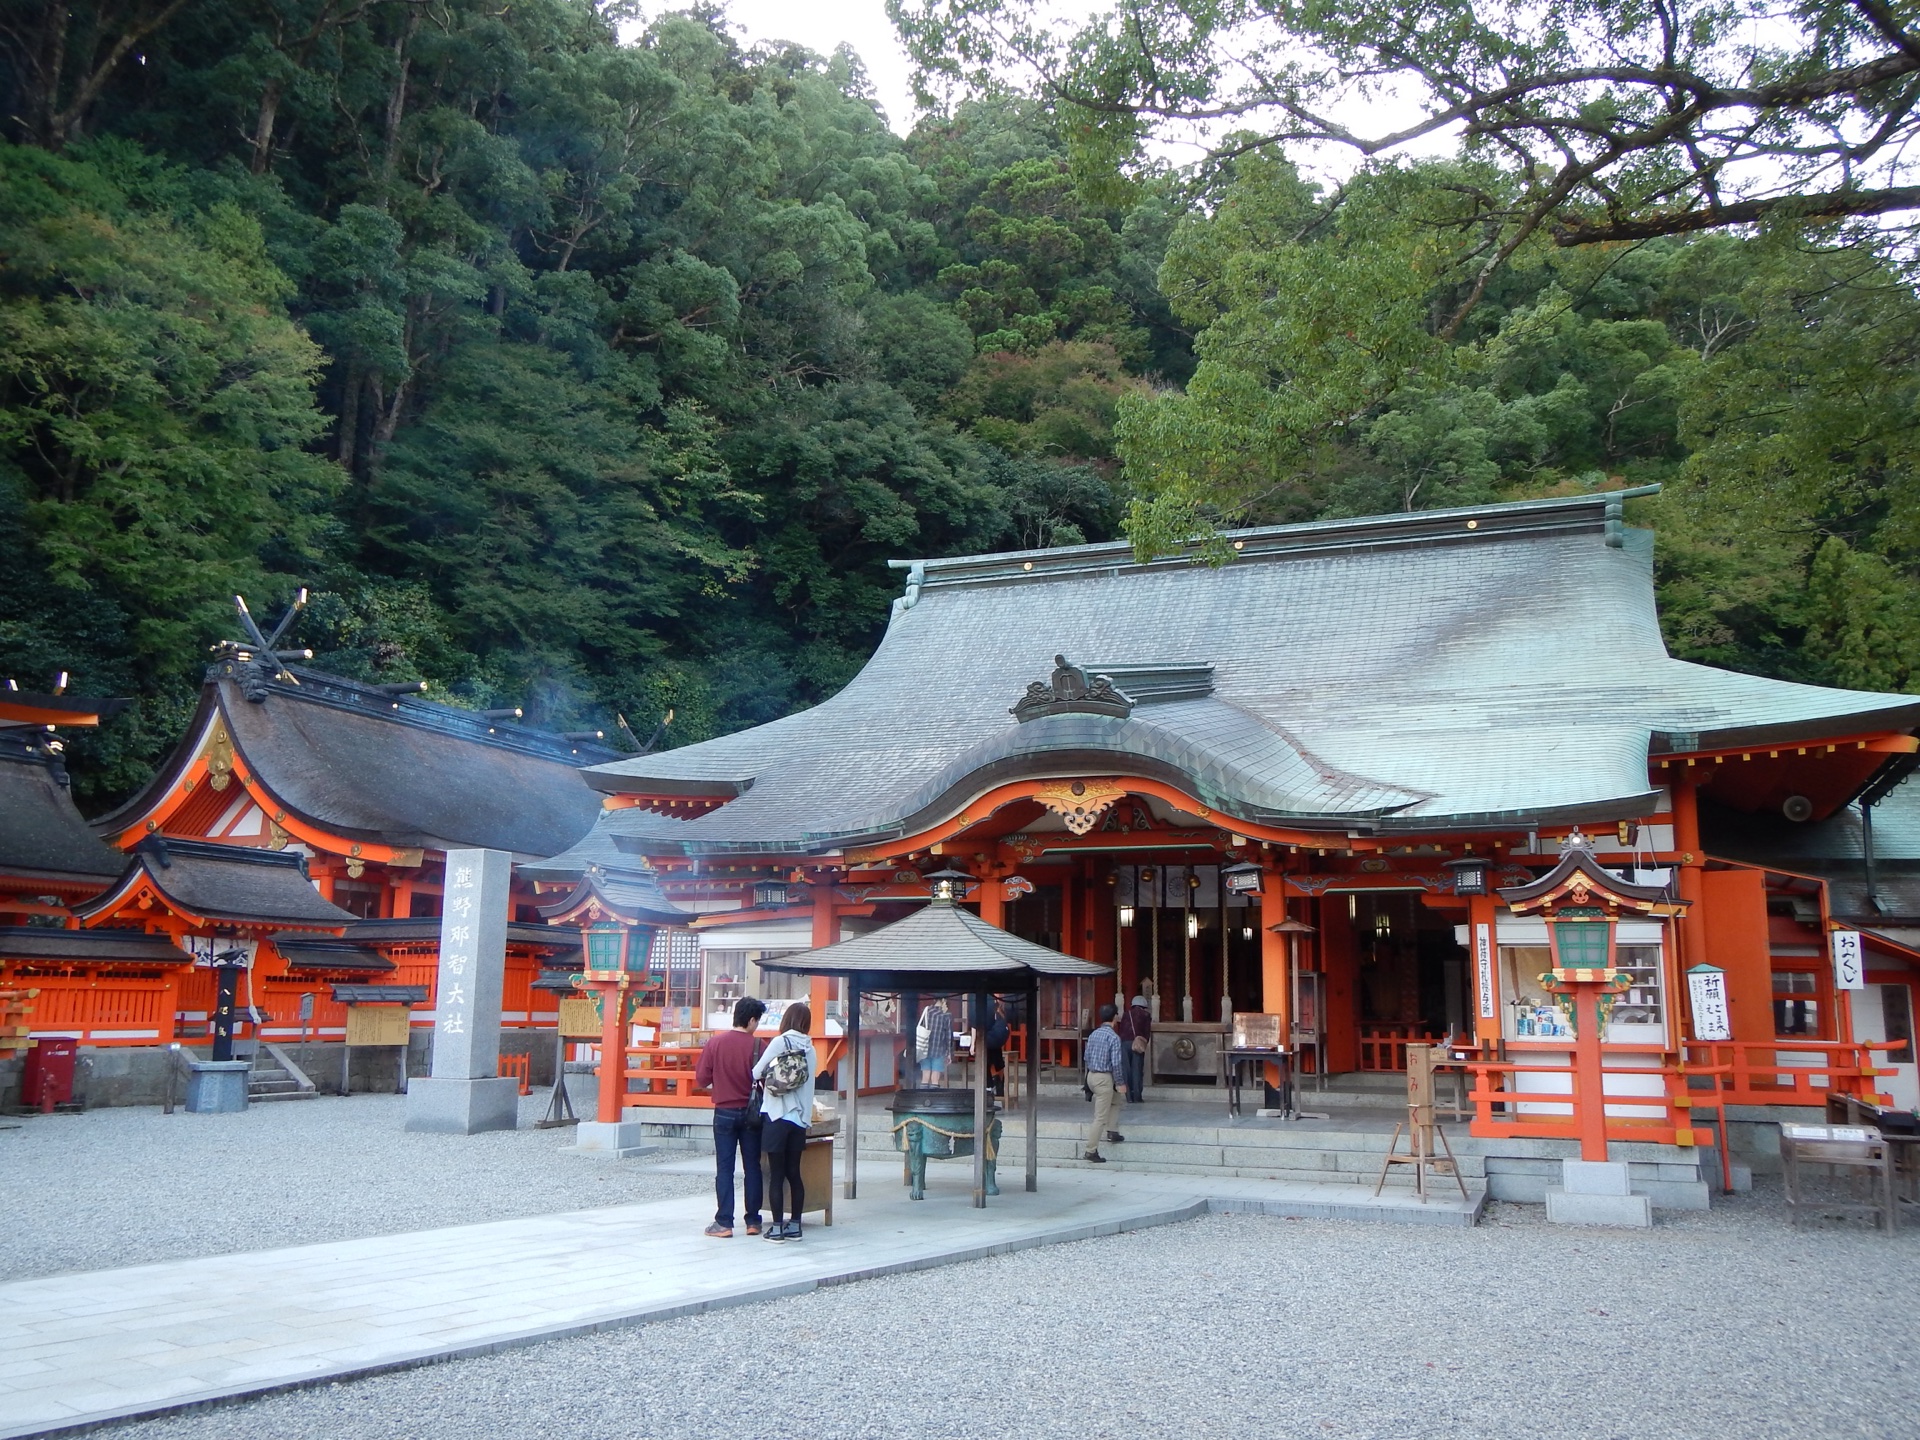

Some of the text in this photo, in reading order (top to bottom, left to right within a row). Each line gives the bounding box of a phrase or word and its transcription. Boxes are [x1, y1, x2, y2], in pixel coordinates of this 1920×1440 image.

[443, 867, 474, 1034] 熊野那智大社
[1840, 936, 1858, 983] おみくじ
[1704, 974, 1721, 1001] 祈願
